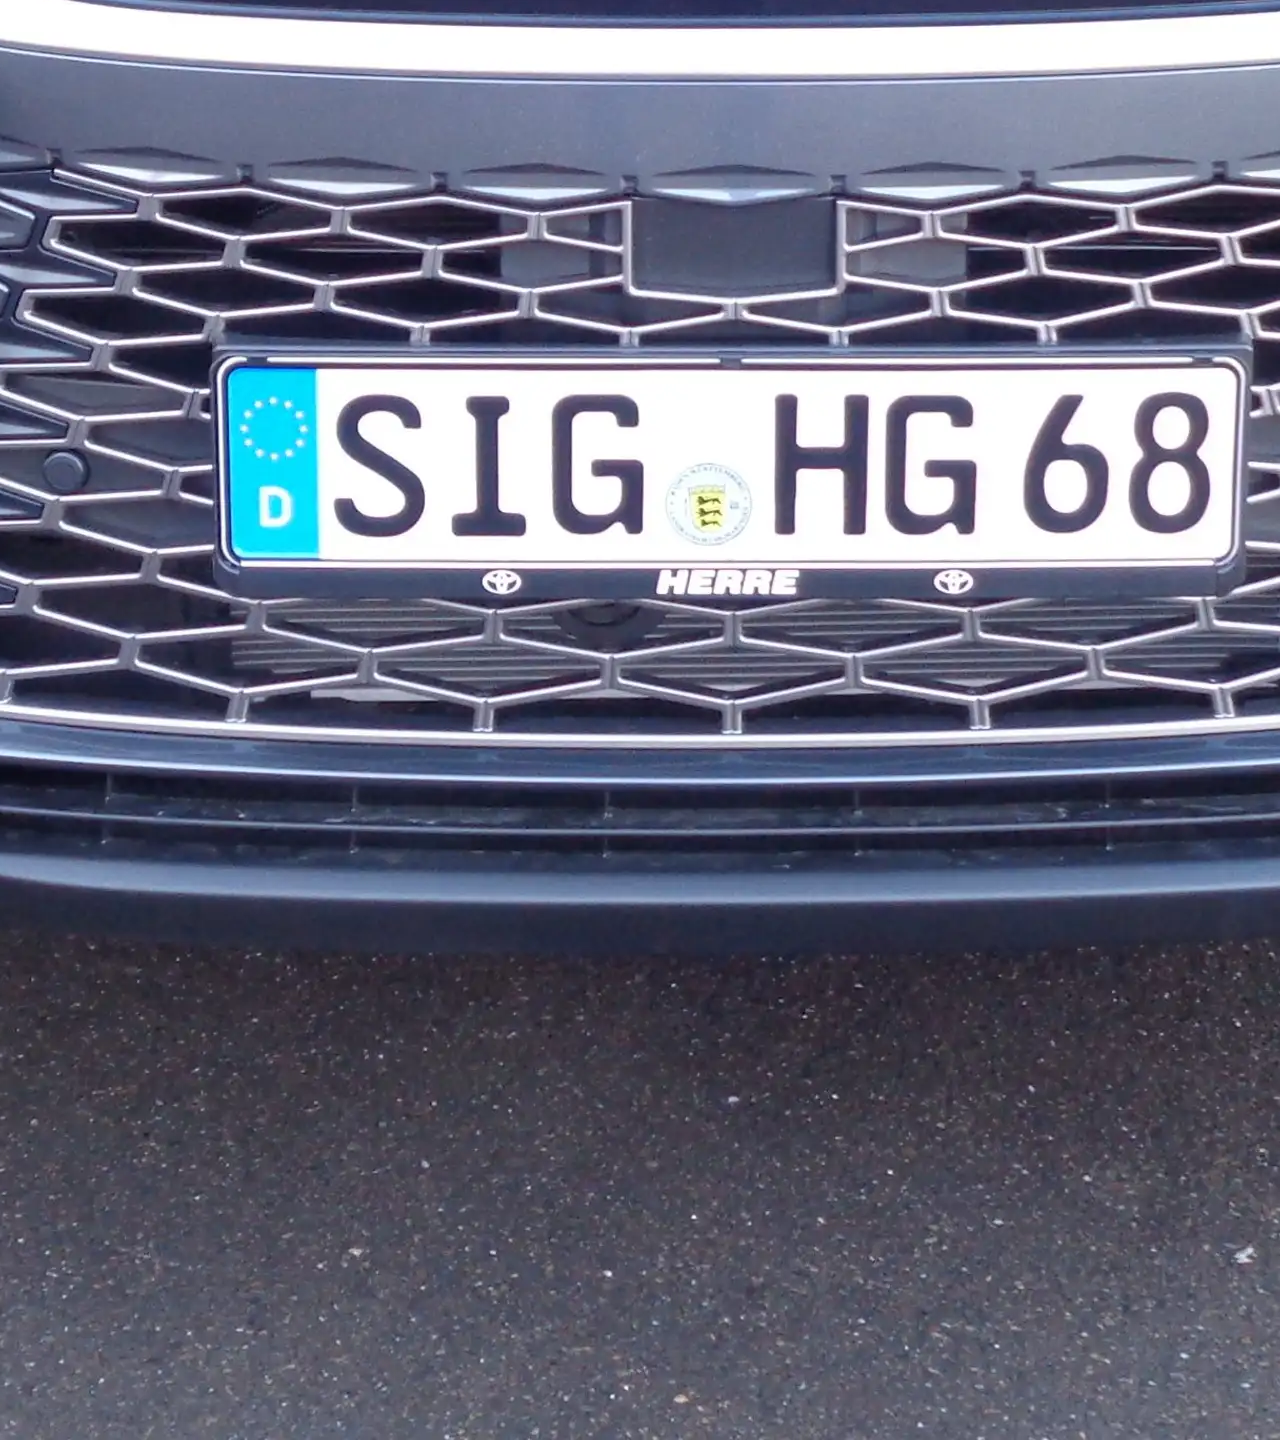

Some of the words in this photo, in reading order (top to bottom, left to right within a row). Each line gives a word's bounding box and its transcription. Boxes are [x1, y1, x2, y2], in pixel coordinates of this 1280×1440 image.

[335, 395, 644, 537] SIG
[776, 395, 977, 535] HG
[1024, 393, 1210, 534] 68
[259, 486, 292, 527] D
[656, 569, 800, 595] HERRE
